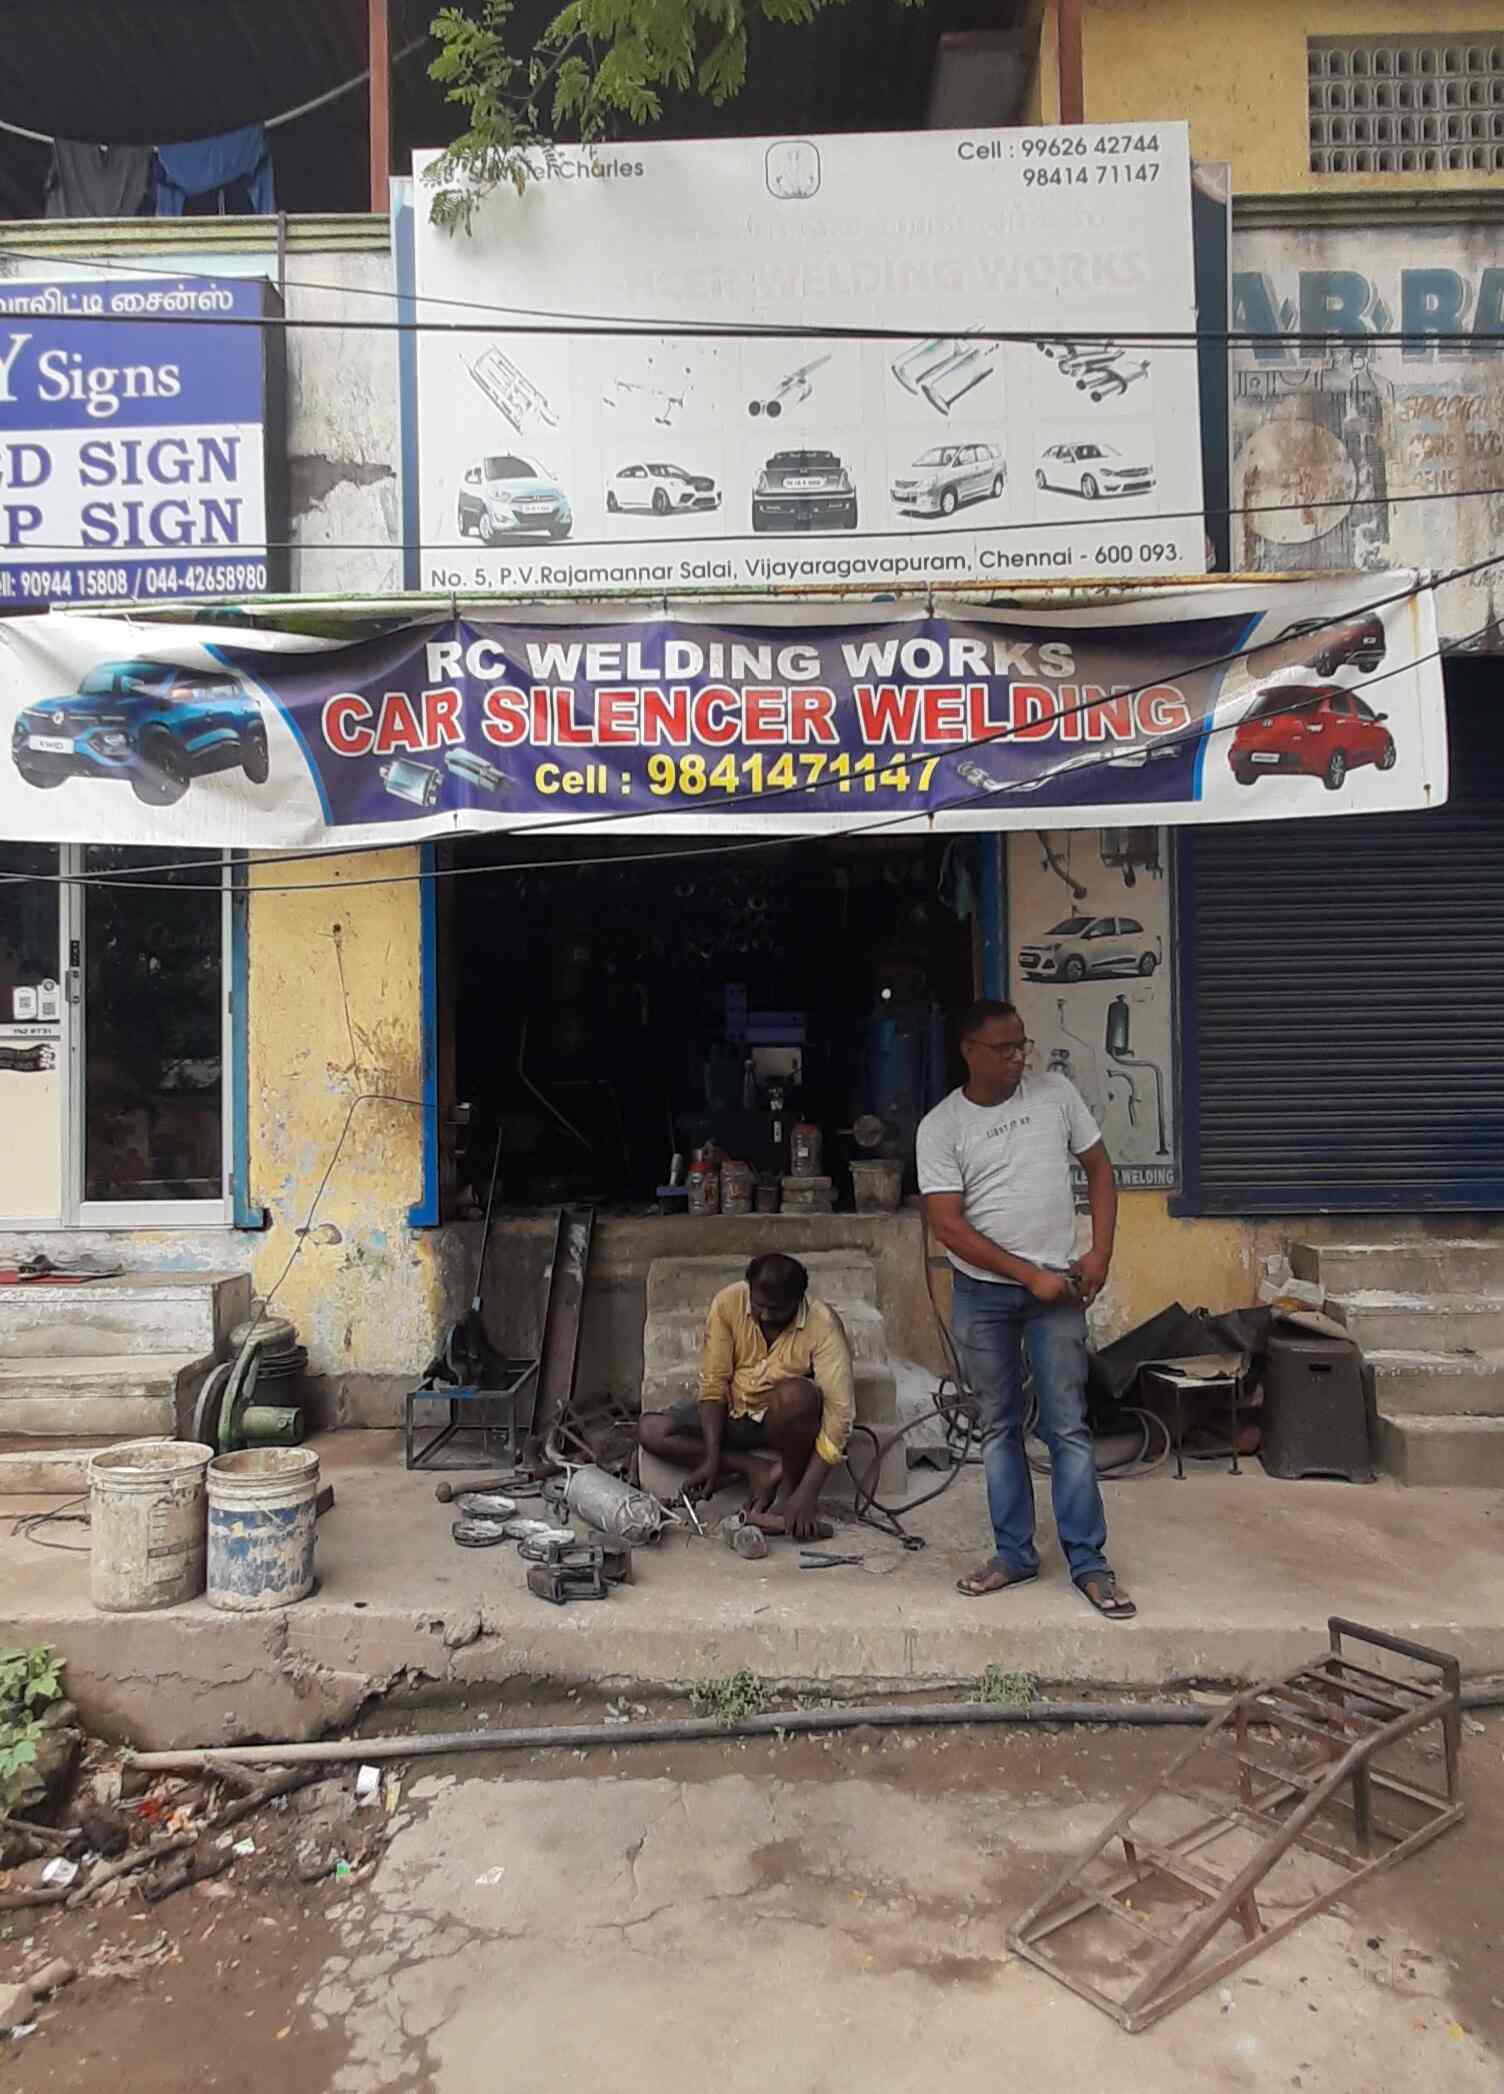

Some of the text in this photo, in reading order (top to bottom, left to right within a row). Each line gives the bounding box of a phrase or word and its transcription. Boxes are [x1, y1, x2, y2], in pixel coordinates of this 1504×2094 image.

[957, 141, 1002, 161] Cell
[1021, 136, 1088, 158] 99626
[1094, 134, 1160, 155] 42744
[1022, 163, 1160, 187] 98414 71147
[38, 350, 182, 418] Signs
[0, 436, 242, 490] D SIGN
[80, 498, 243, 548] SIGN
[20, 570, 73, 597] 90944
[77, 567, 128, 595] 15808
[146, 563, 267, 594] 044-42658980
[430, 569, 467, 588] No.
[473, 567, 493, 588] 5,
[680, 560, 738, 581] Salai,
[745, 554, 972, 580] Vijayaragavapuram,
[979, 547, 1073, 569] Chennai
[1094, 545, 1134, 565] 600
[1140, 543, 1183, 562] 093.
[425, 638, 1076, 682] RC WELDING WORKS
[321, 683, 1191, 758] CAR SILENCER WELDING
[535, 761, 608, 794] Cell
[646, 751, 941, 796] 9841471147
[1120, 1167, 1175, 1185] WELDING
